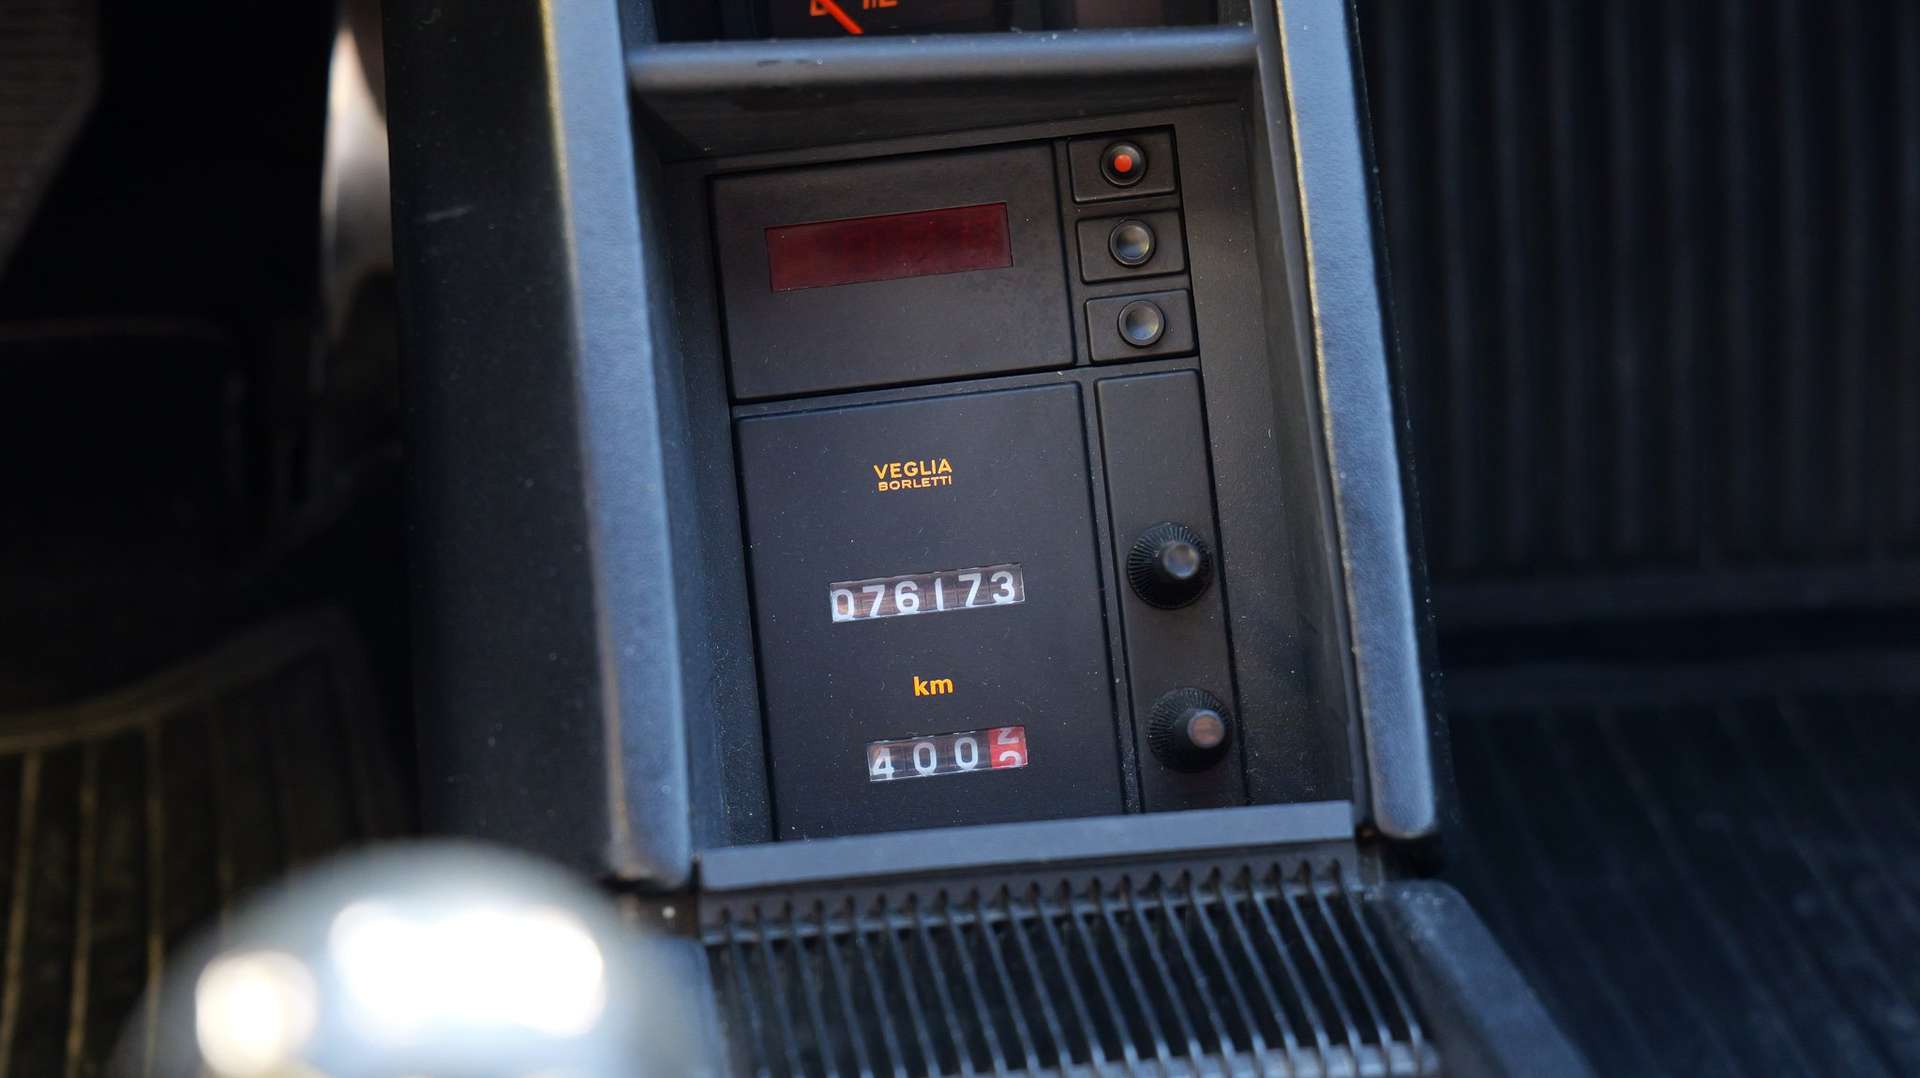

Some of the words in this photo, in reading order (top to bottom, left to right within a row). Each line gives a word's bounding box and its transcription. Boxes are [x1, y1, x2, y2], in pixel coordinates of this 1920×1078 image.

[873, 458, 953, 480] VEGLIA
[878, 475, 953, 492] BORLETTI
[831, 571, 1016, 621] 076173
[913, 675, 954, 697] km
